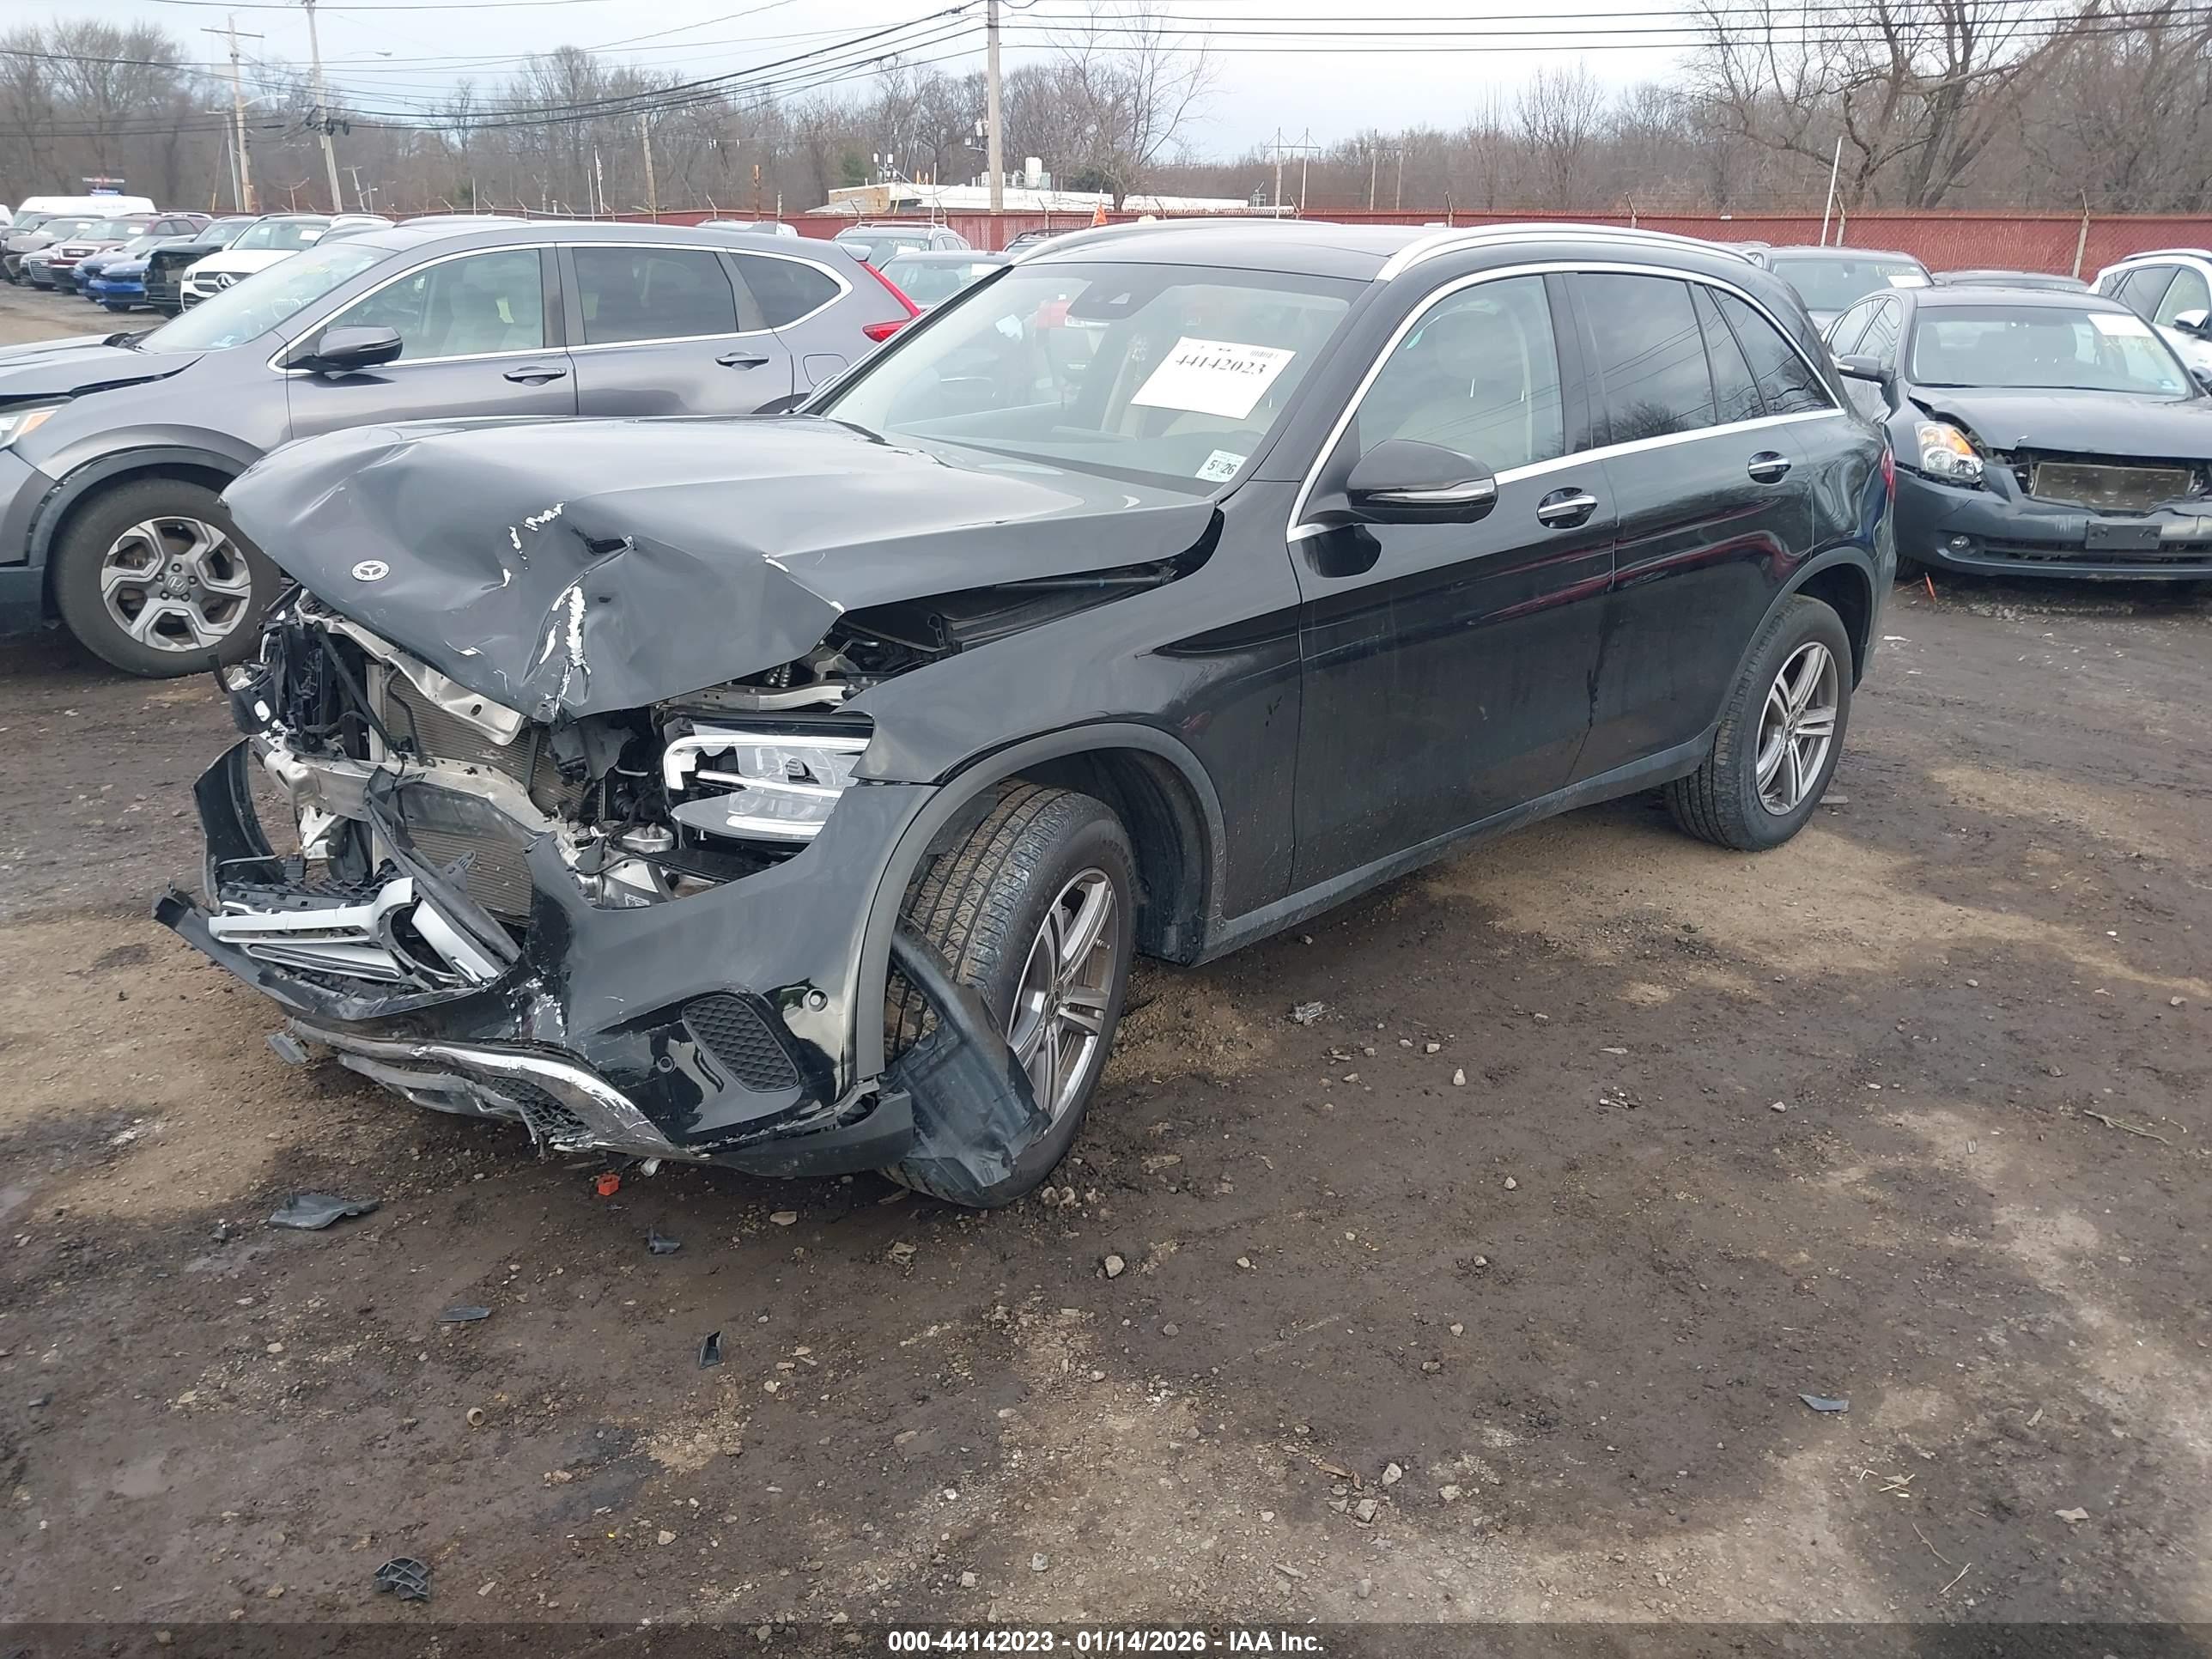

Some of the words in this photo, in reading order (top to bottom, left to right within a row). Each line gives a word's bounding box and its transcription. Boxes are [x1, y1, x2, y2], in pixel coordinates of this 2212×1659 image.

[1176, 355, 1267, 374] 44142023
[1207, 460, 1218, 471] 5
[1221, 463, 1237, 475] 26
